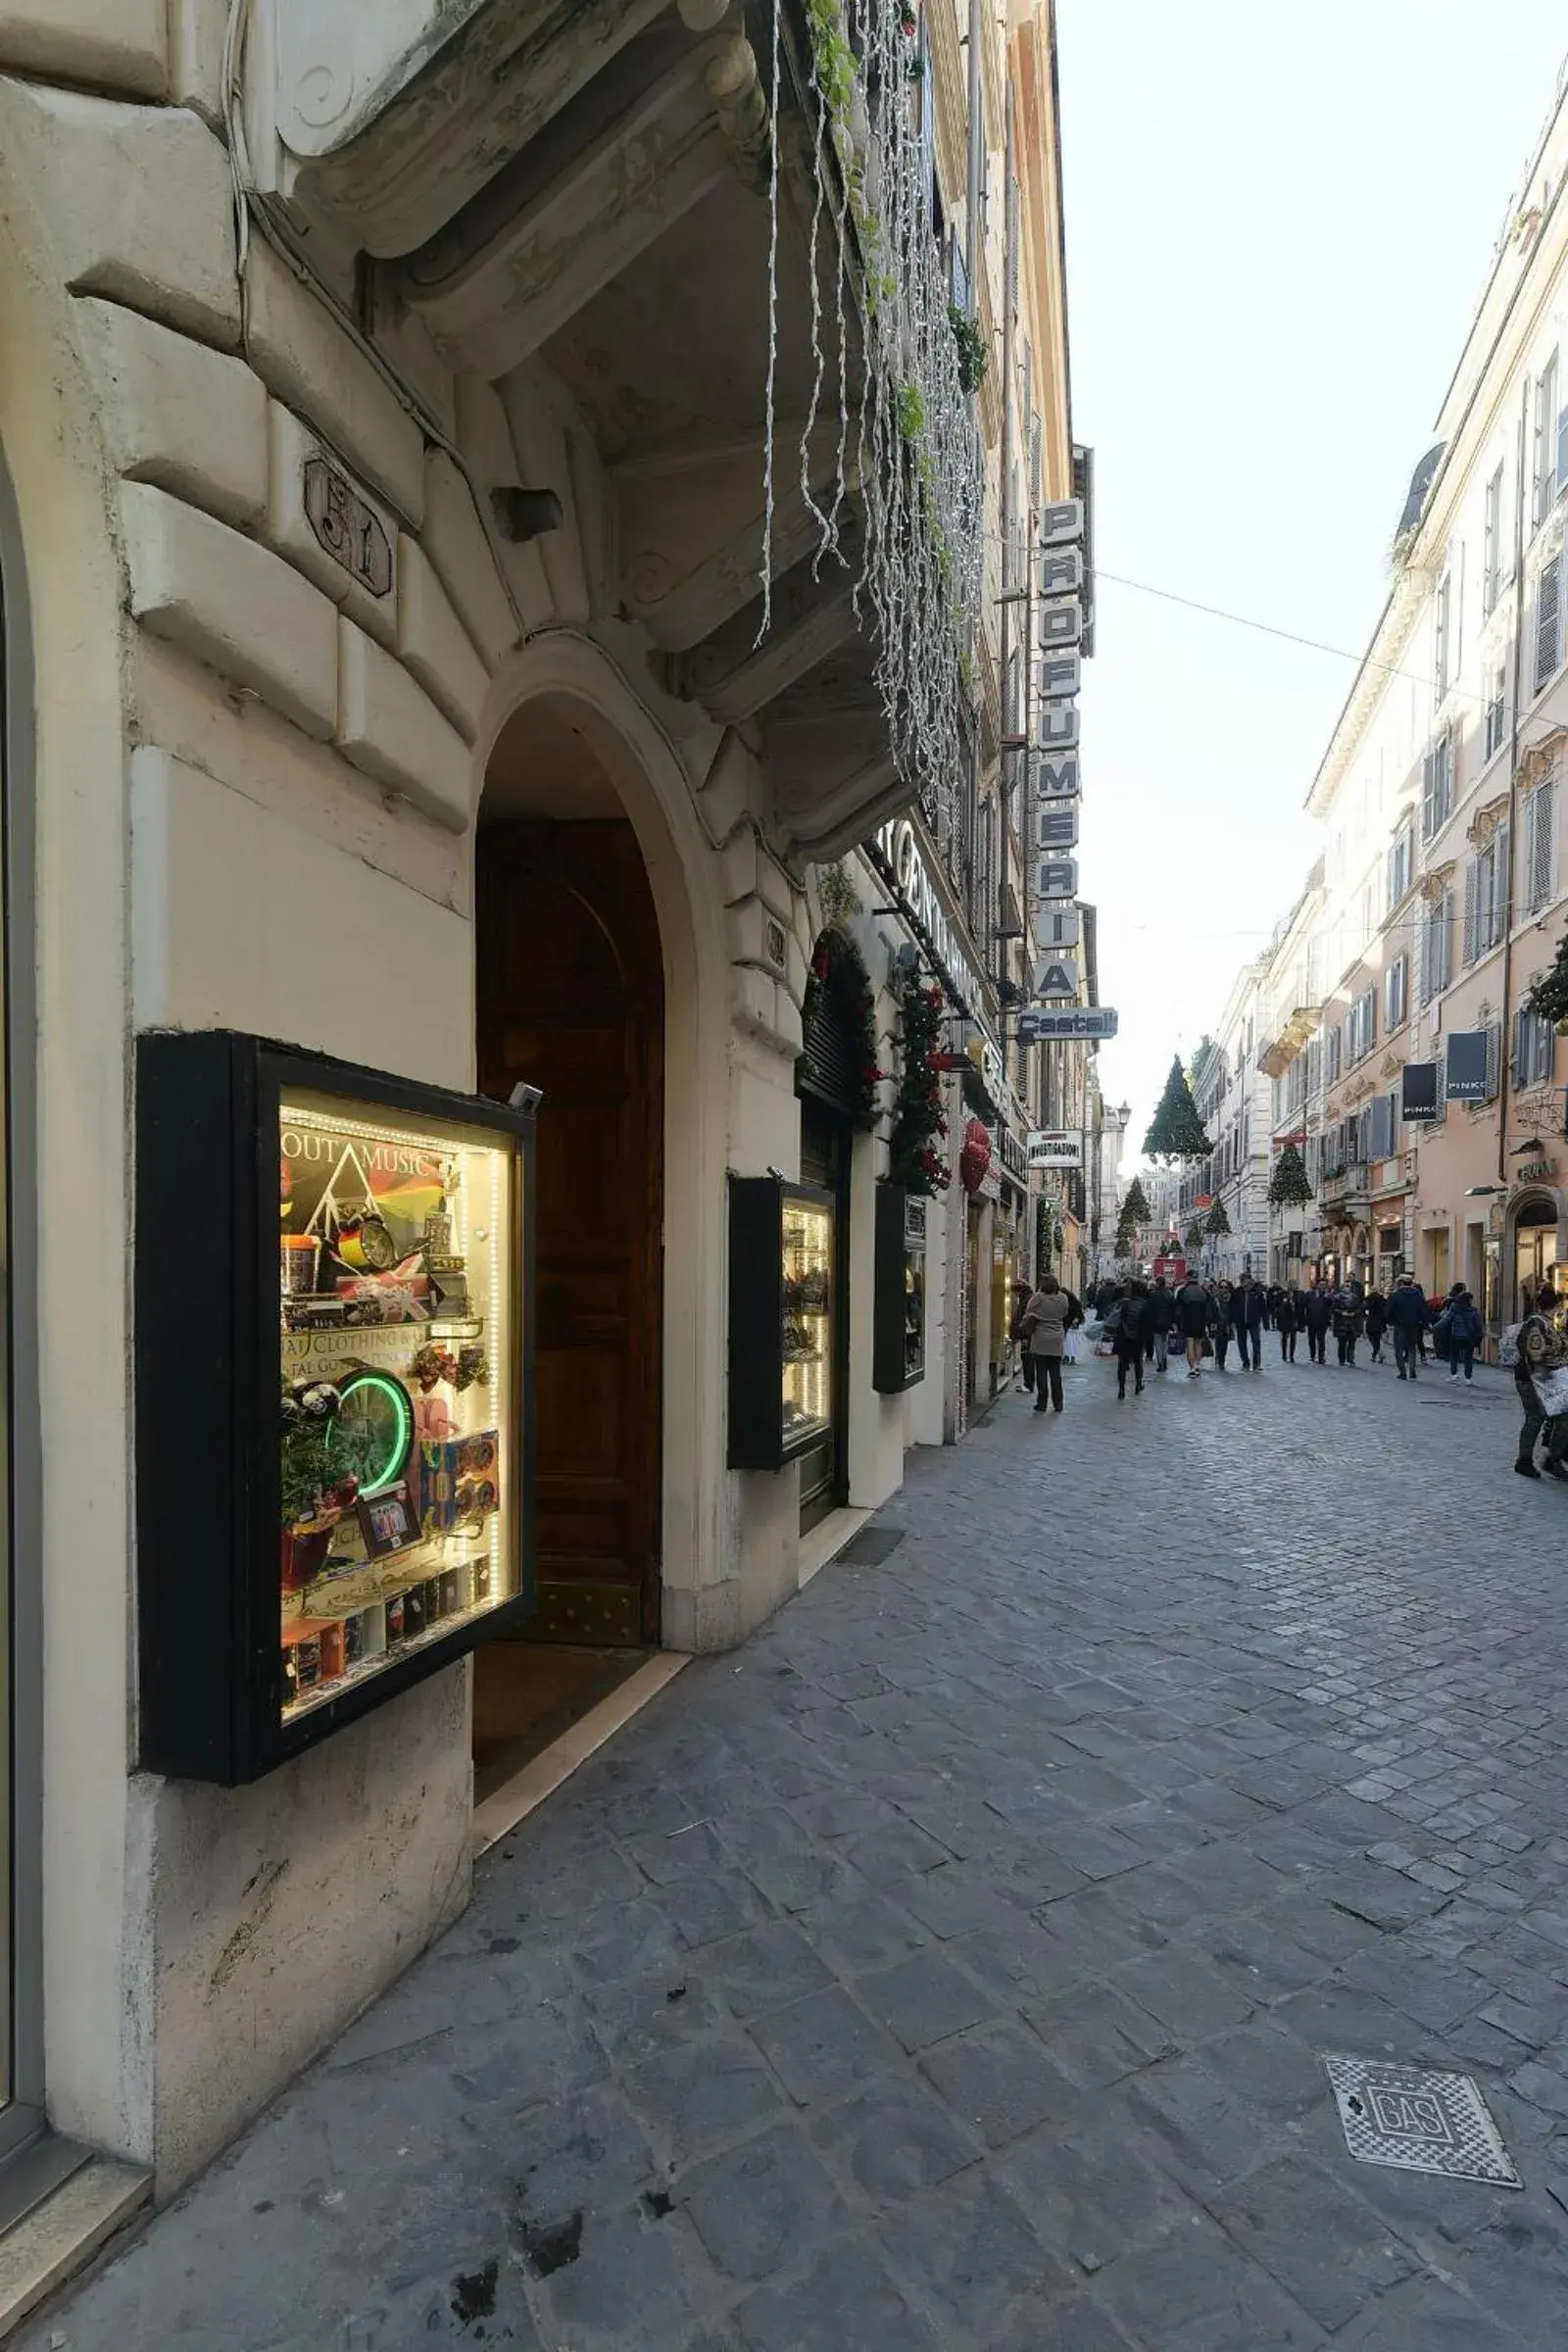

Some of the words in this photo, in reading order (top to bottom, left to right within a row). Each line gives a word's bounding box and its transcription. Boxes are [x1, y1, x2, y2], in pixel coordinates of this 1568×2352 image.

[361, 1145, 429, 1177] MUSIC
[314, 1330, 397, 1354] CLOTHING
[1376, 2094, 1445, 2134] GAS
